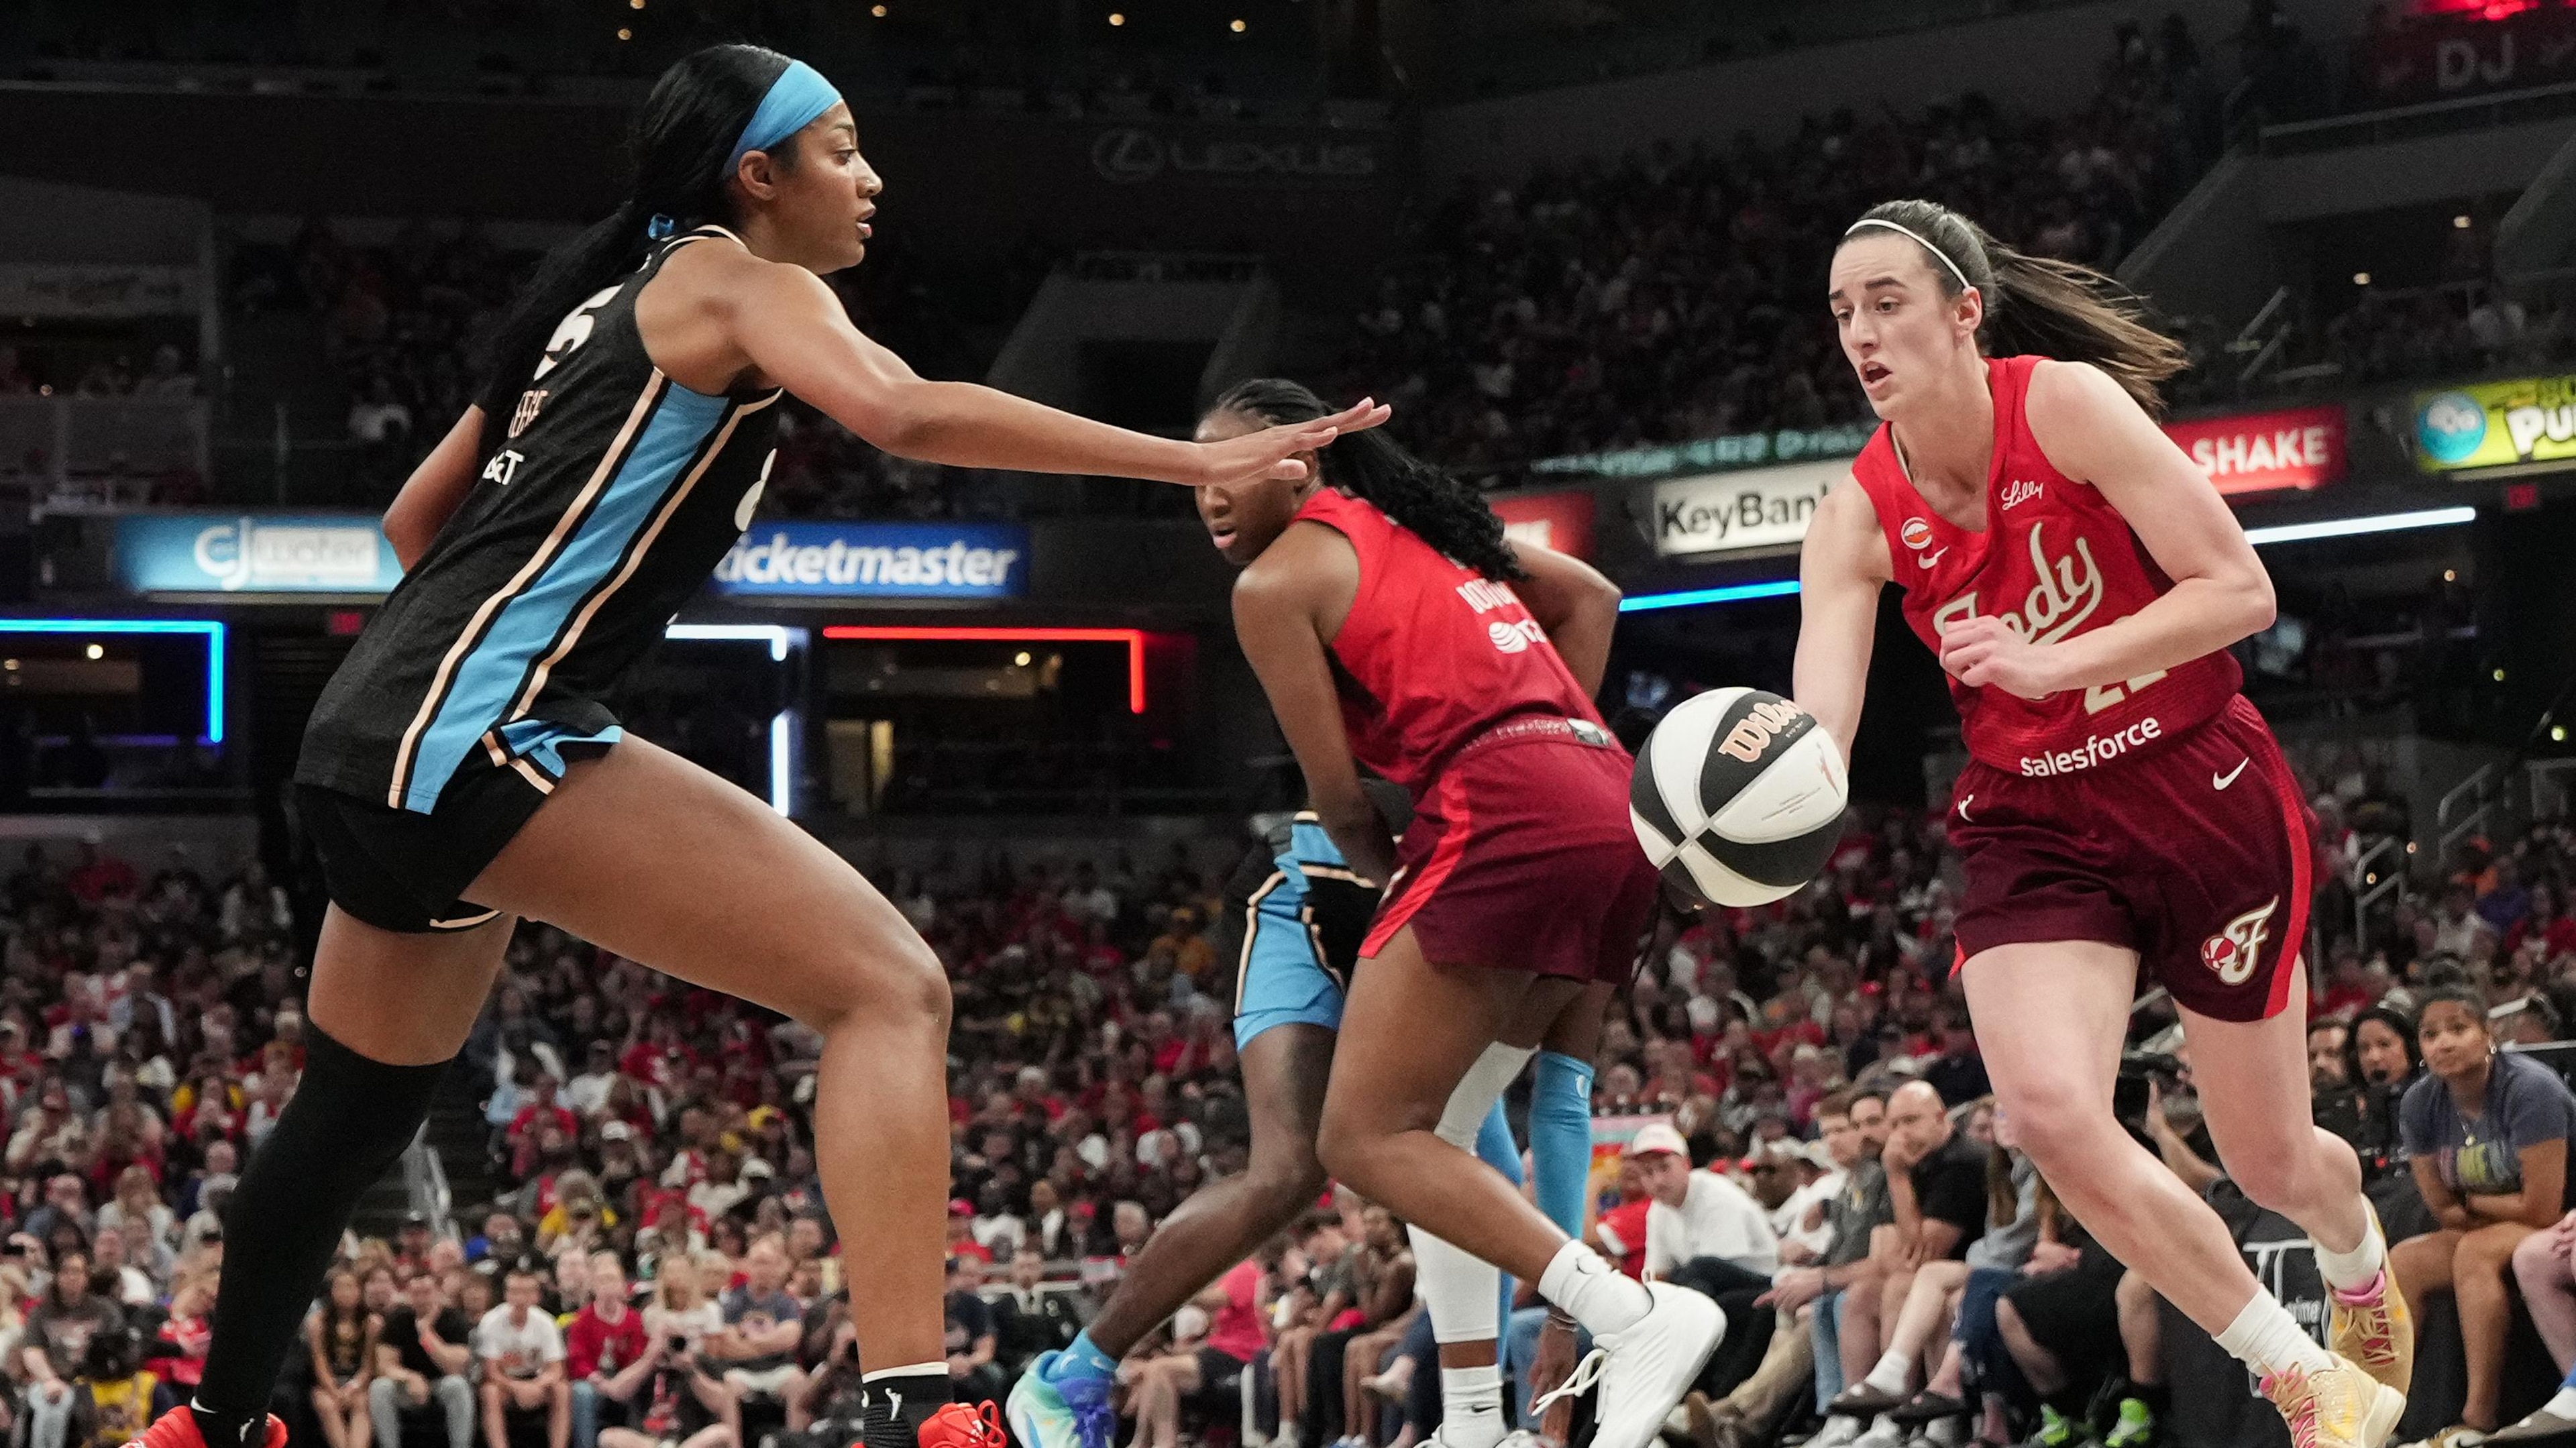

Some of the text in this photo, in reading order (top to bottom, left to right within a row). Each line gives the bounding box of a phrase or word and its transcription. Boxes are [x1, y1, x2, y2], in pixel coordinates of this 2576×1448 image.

[2437, 33, 2516, 89] DJ
[1170, 140, 1375, 175] LEXUS
[2190, 427, 2330, 477] SHAKE
[2506, 405, 2576, 456] PU
[1660, 482, 1828, 539] KeyBan
[2001, 480, 2044, 510] Lilly
[2020, 717, 2162, 777] salesforce
